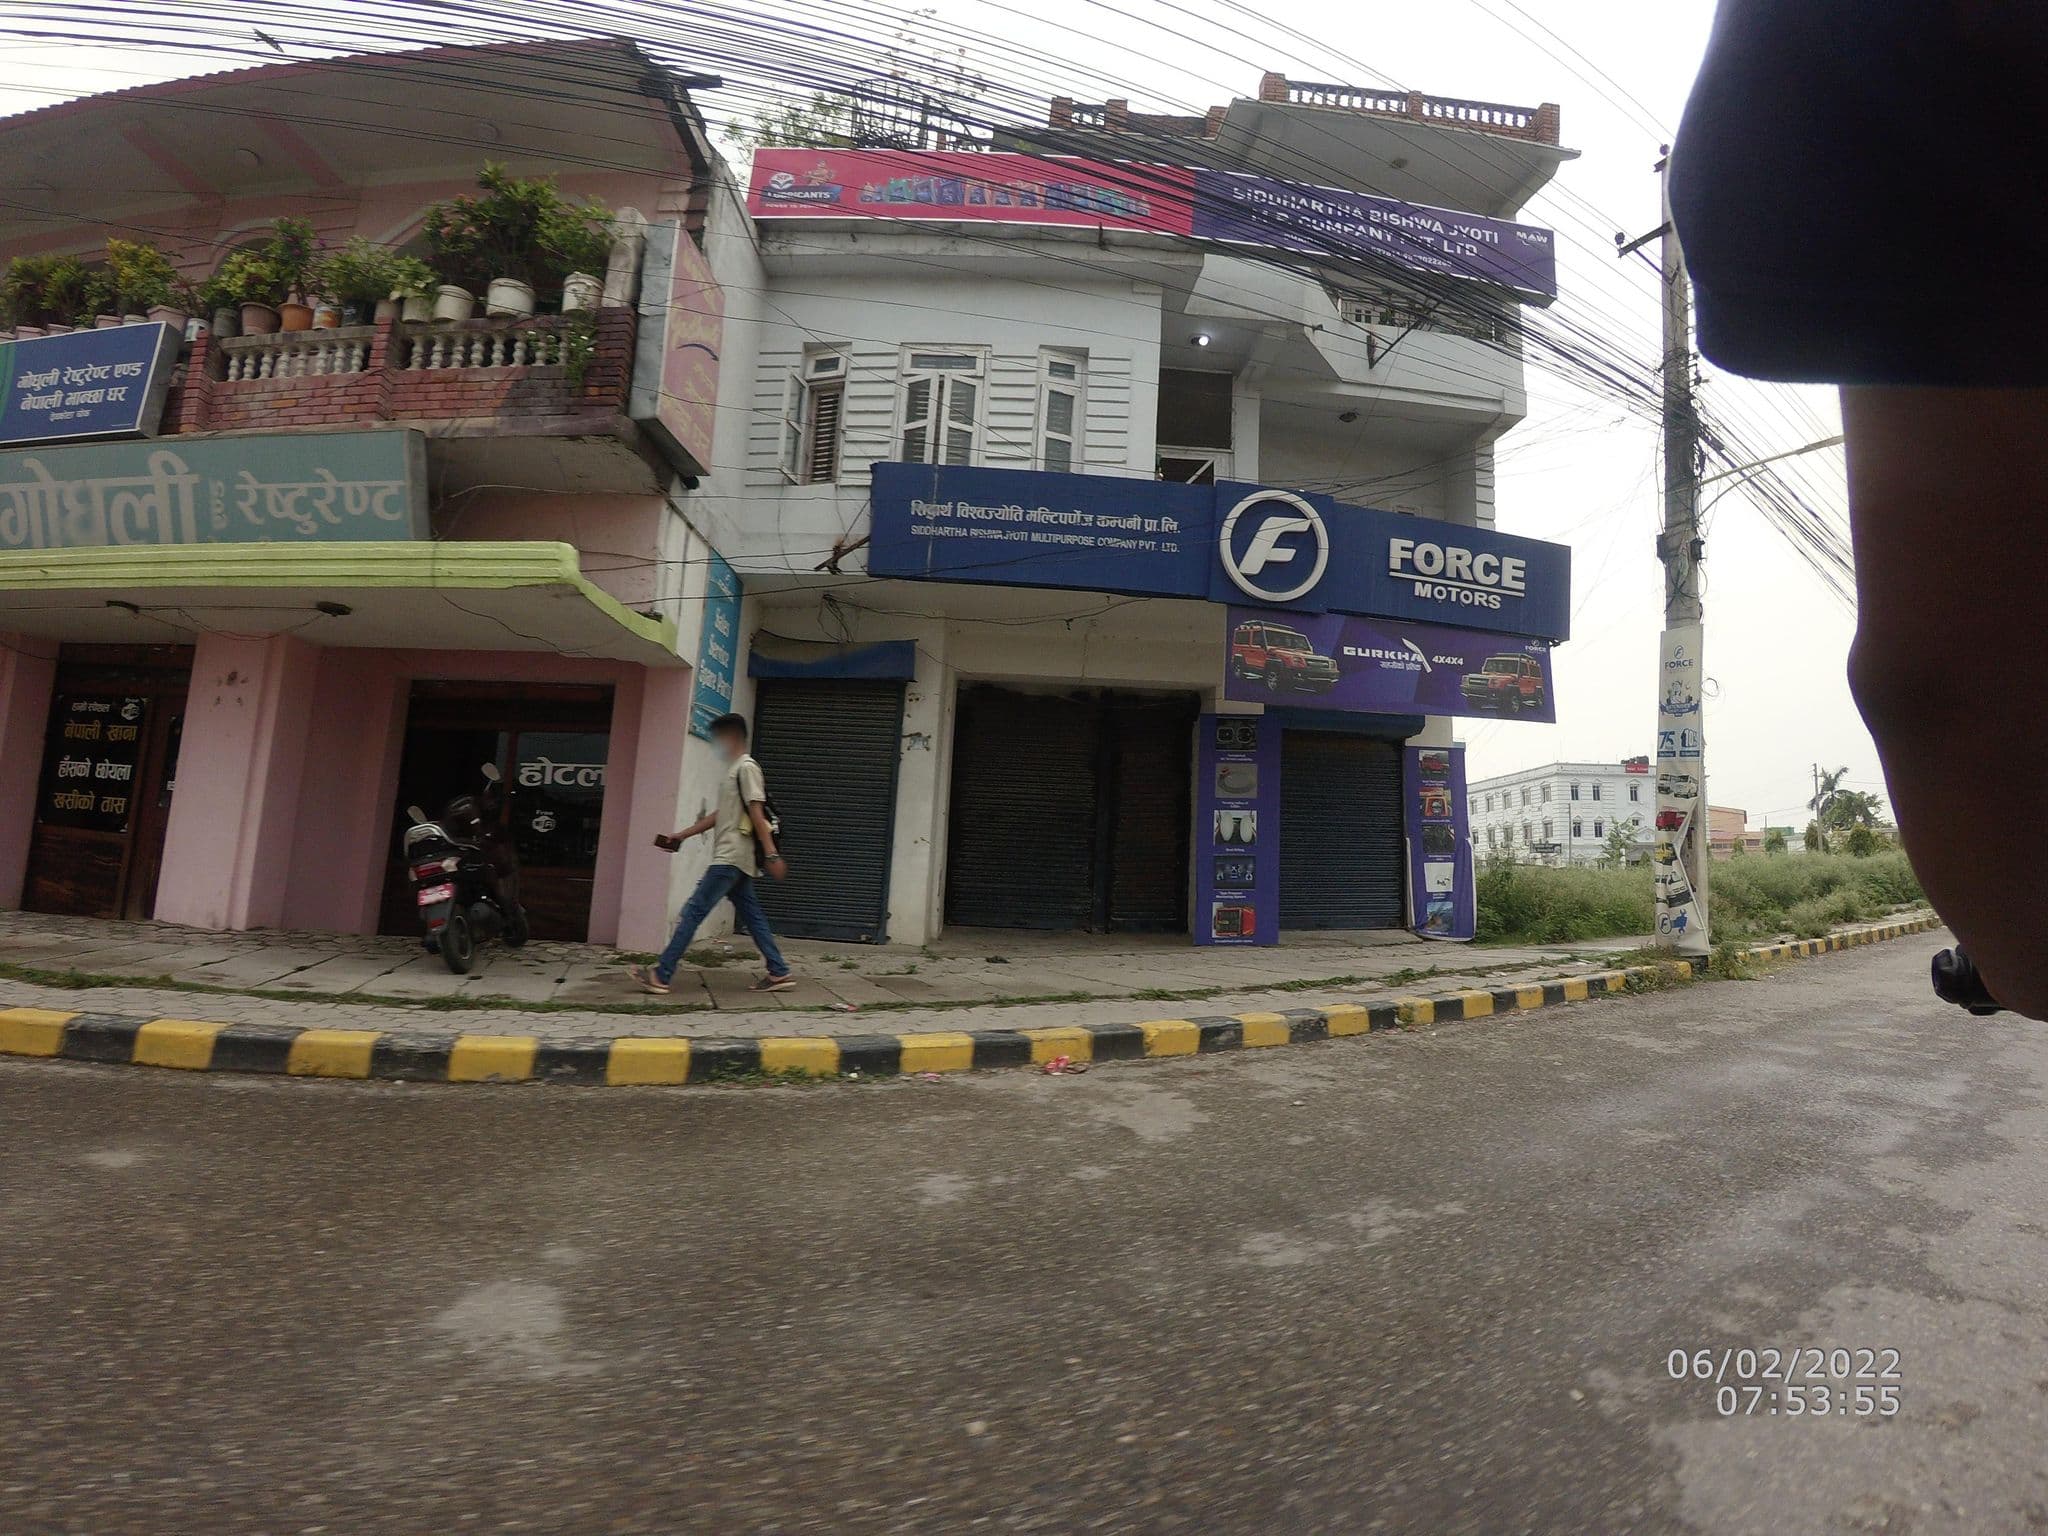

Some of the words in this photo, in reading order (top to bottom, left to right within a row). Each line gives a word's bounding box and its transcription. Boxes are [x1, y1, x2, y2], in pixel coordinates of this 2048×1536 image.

[1369, 209, 1444, 235] BISHWA
[113, 362, 145, 378] एण्ड
[20, 389, 64, 411] नेपाली
[107, 386, 129, 402] घर
[956, 501, 1025, 522] विश्वज्योति
[1096, 513, 1143, 531] कम्पनी
[911, 525, 968, 537] SIDDHARTHA
[1030, 532, 1095, 546] MULTIPURPOSE
[1097, 537, 1138, 550] COMPANY
[1161, 541, 1180, 553] LTD.
[1388, 537, 1527, 591] FORCE
[1413, 581, 1502, 610] MOTORS
[1343, 645, 1425, 663] GURKHA
[1431, 654, 1465, 666] 4X4X4
[1664, 658, 1694, 670] FORCE
[106, 724, 138, 741] खाना
[517, 756, 608, 788] होटल
